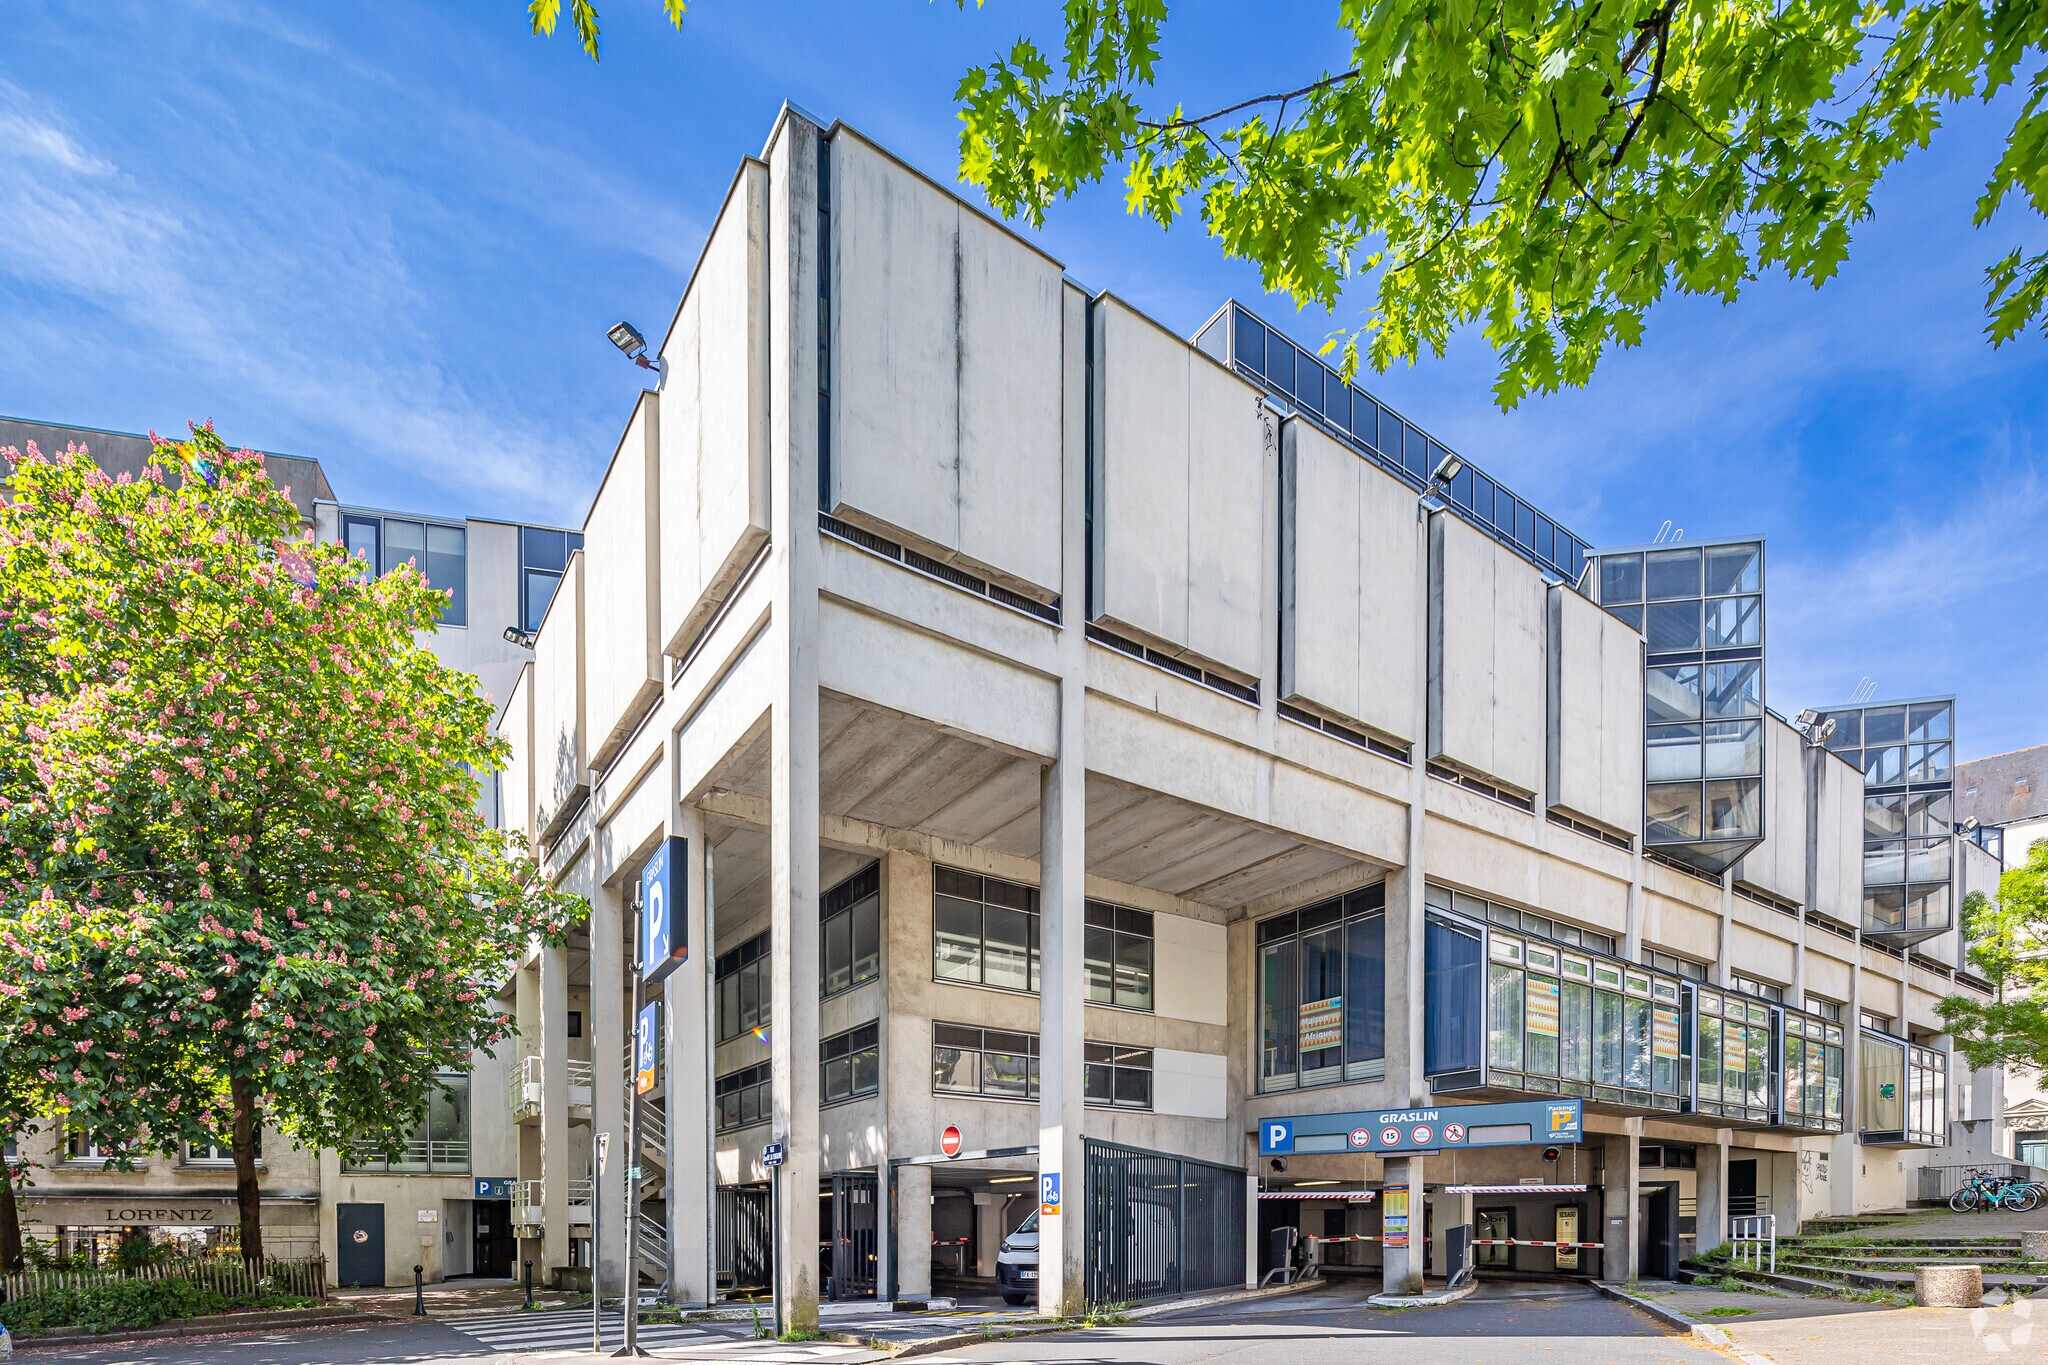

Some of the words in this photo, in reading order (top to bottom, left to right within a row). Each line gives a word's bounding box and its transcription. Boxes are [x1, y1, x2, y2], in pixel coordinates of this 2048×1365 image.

[646, 853, 664, 886] GRASLIN
[649, 880, 664, 966] P
[1302, 1014, 1329, 1025] Maison
[640, 1016, 649, 1068] P
[1379, 1111, 1439, 1123] GRASLIN
[1270, 1125, 1287, 1149] P
[1386, 1132, 1395, 1140] 15
[480, 1181, 490, 1194] P
[1042, 1177, 1053, 1203] P
[106, 1209, 213, 1221] LORENTZ
